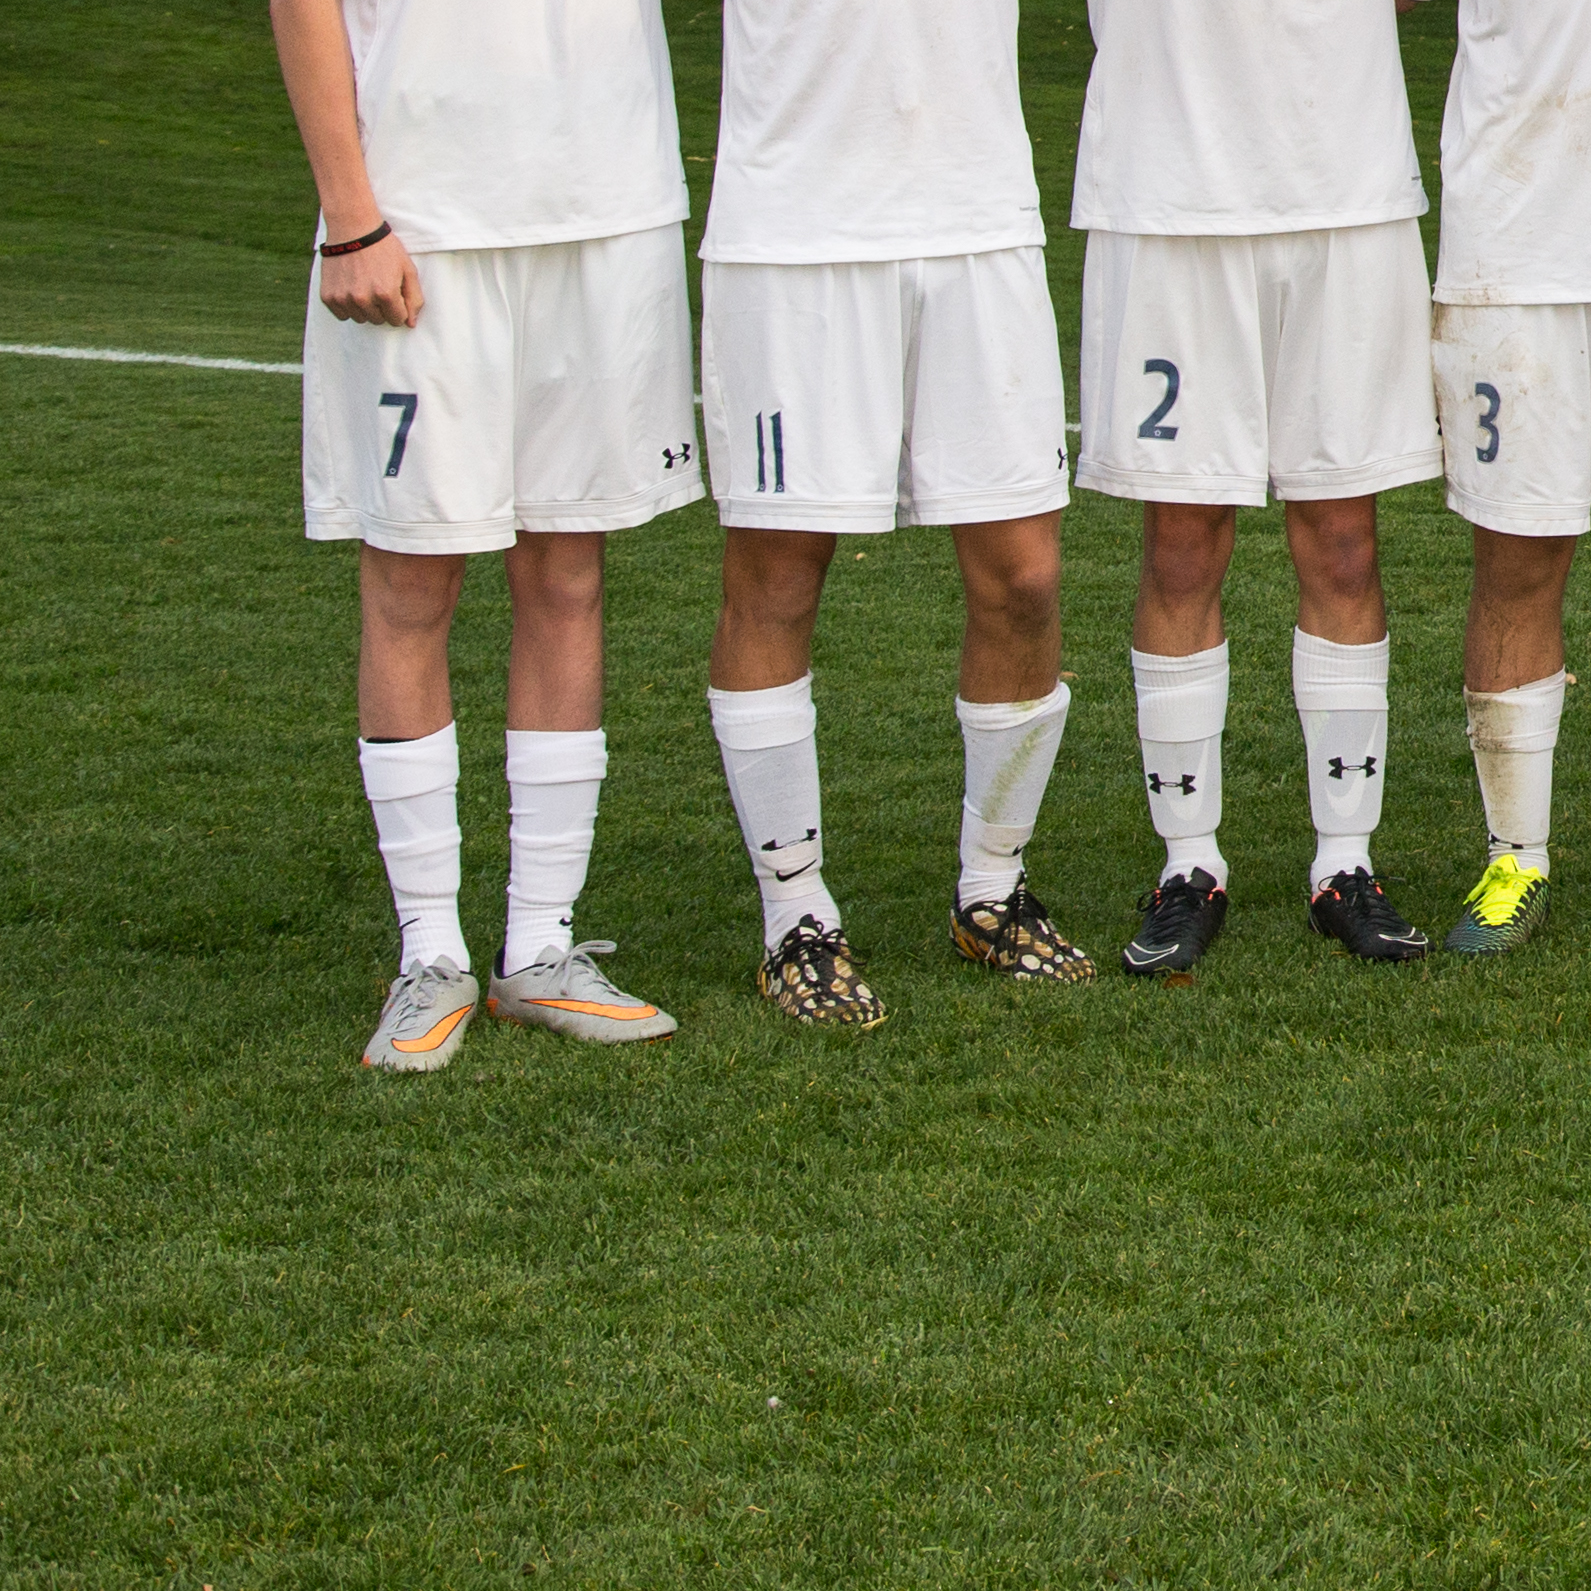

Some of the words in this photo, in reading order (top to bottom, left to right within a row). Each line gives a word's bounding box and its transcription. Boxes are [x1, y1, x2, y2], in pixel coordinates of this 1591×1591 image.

[380, 393, 417, 476] 7
[1138, 359, 1179, 440] 2
[1475, 383, 1500, 462] 3
[756, 412, 784, 492] 11
